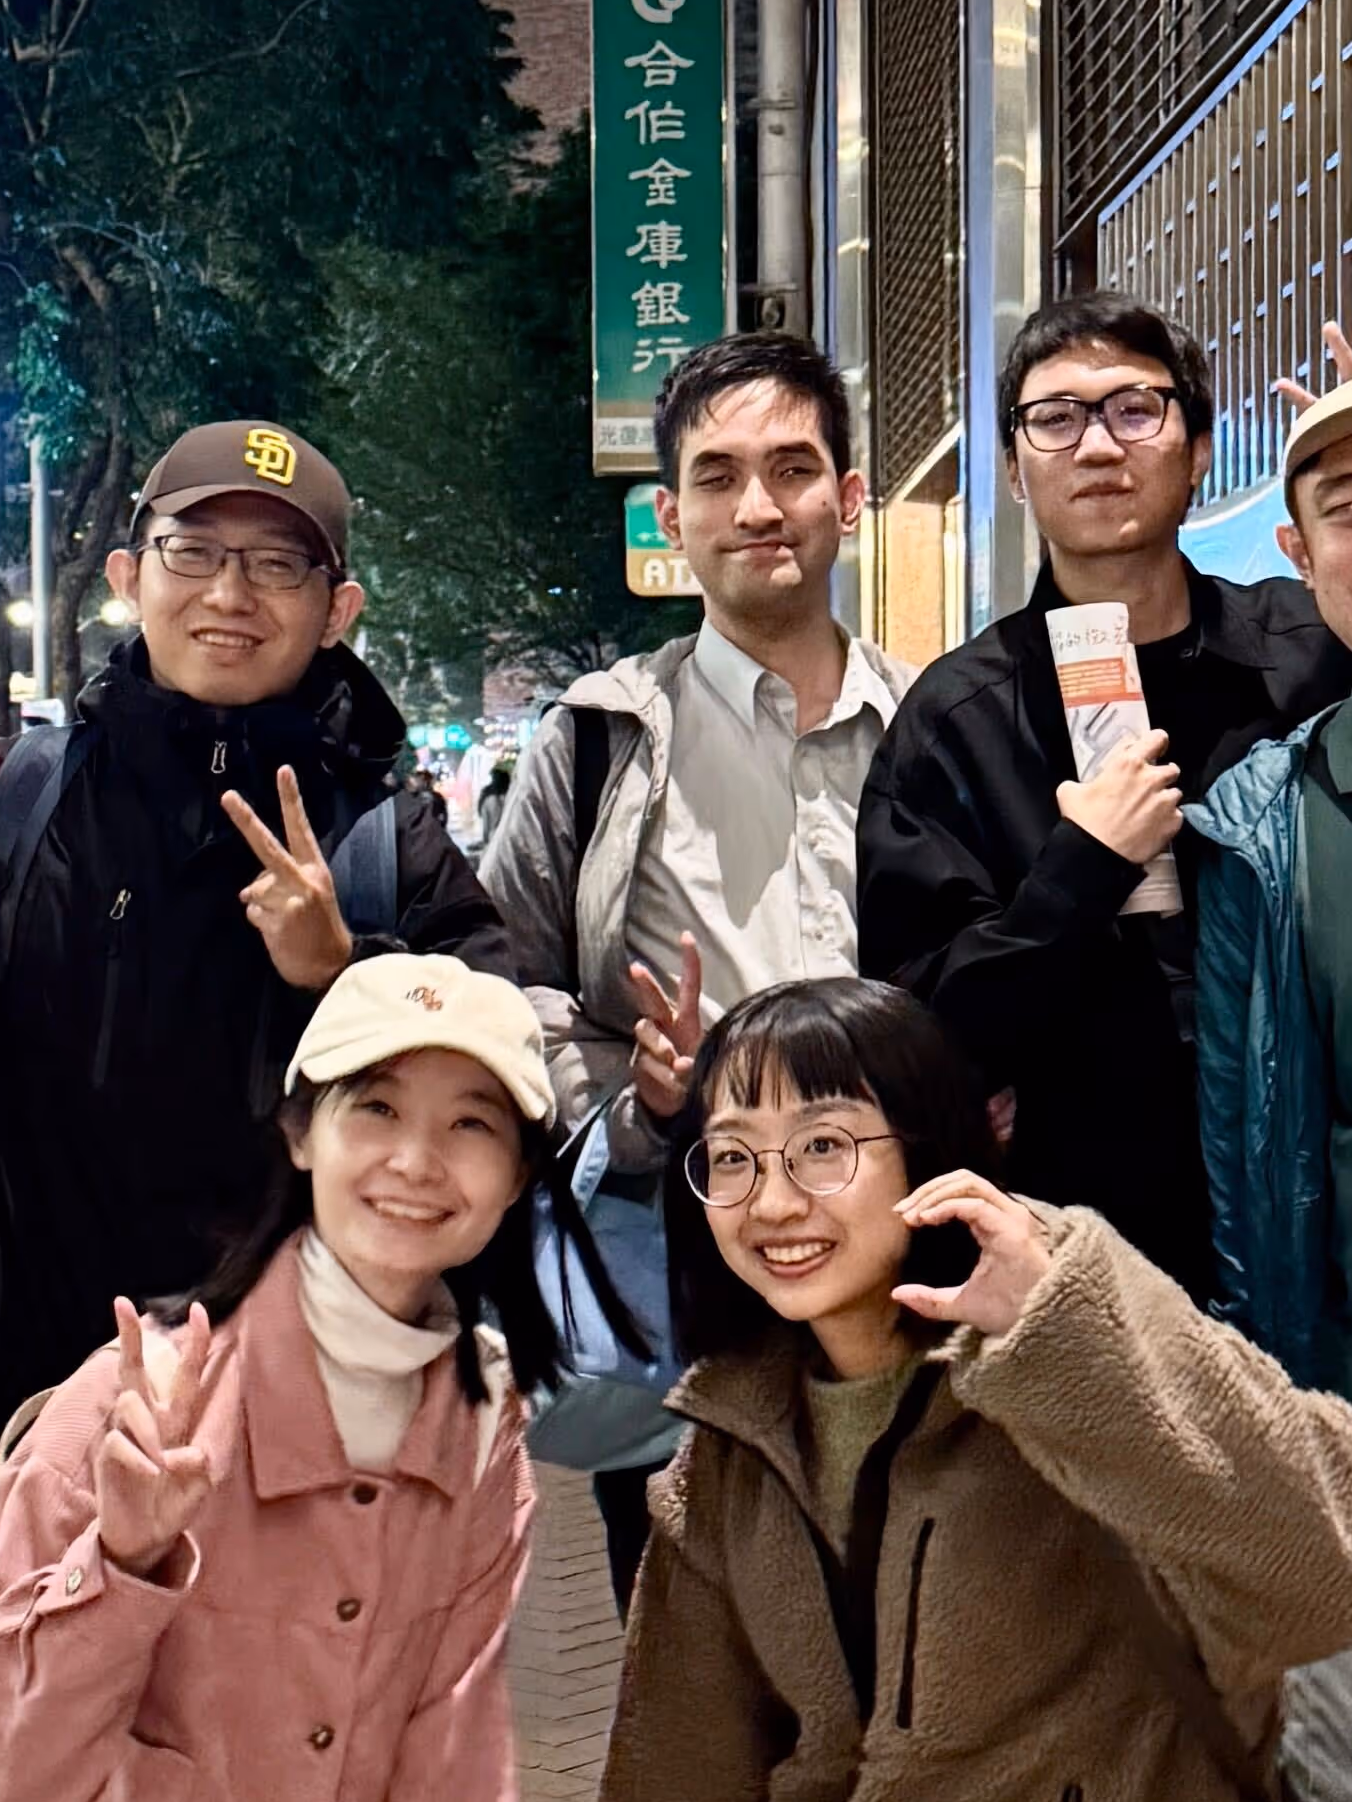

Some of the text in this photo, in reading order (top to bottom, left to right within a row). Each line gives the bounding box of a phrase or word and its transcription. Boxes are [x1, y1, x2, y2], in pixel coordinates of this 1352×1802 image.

[624, 39, 696, 374] 合作金庫銀行
[245, 428, 297, 486] SD
